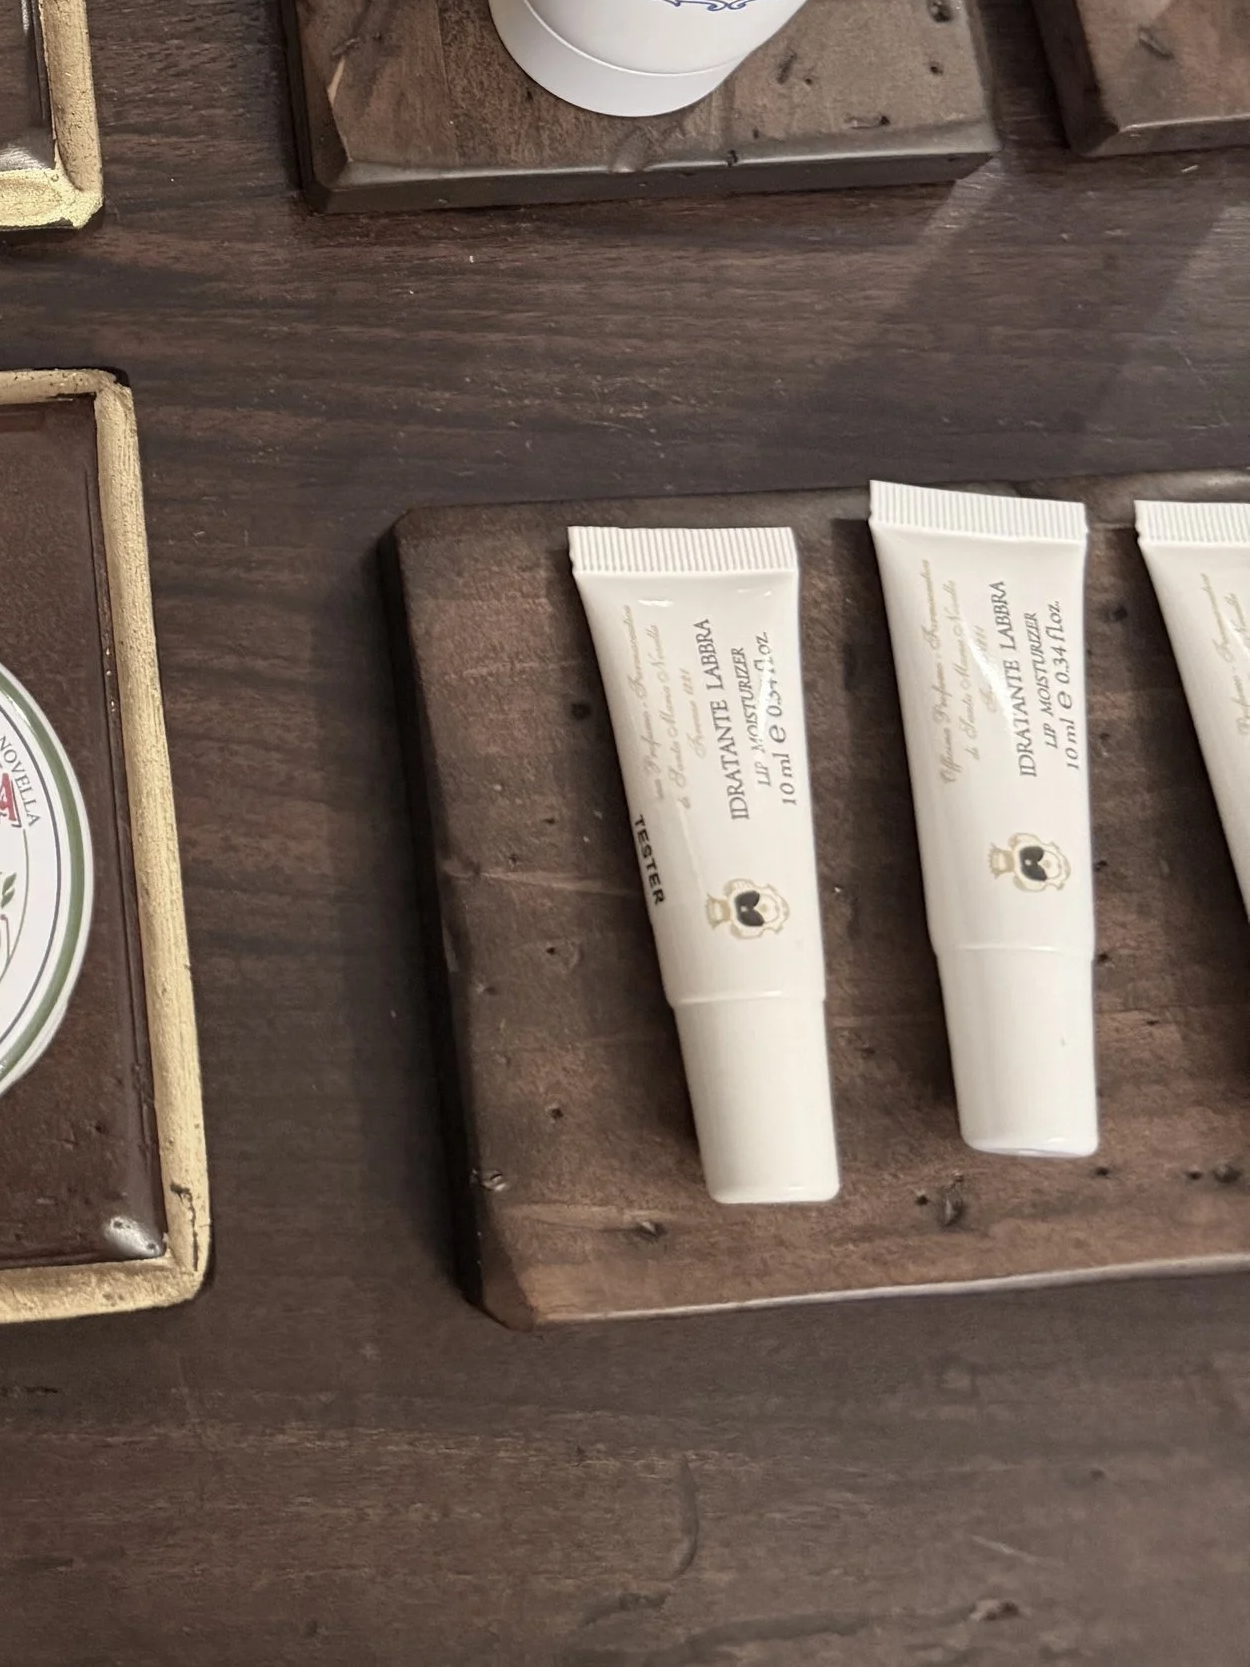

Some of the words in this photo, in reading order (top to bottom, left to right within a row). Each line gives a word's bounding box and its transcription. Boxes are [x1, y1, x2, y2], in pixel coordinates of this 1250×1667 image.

[989, 580, 1018, 651] LABBRA
[693, 618, 726, 691] LABBRA
[1023, 612, 1056, 716] MOISTURIZER
[1053, 646, 1072, 686] 0.34
[730, 646, 767, 754] MOISTURIZER
[1003, 660, 1037, 779] IDRATANTE
[1043, 722, 1059, 750] LIP
[1061, 716, 1080, 746] ml
[709, 699, 750, 821] IDRATANTE
[756, 761, 772, 788] LIP
[772, 752, 796, 777] ml
[1065, 747, 1080, 771] 10
[779, 783, 798, 807] 10
[633, 814, 665, 906] TESTER
